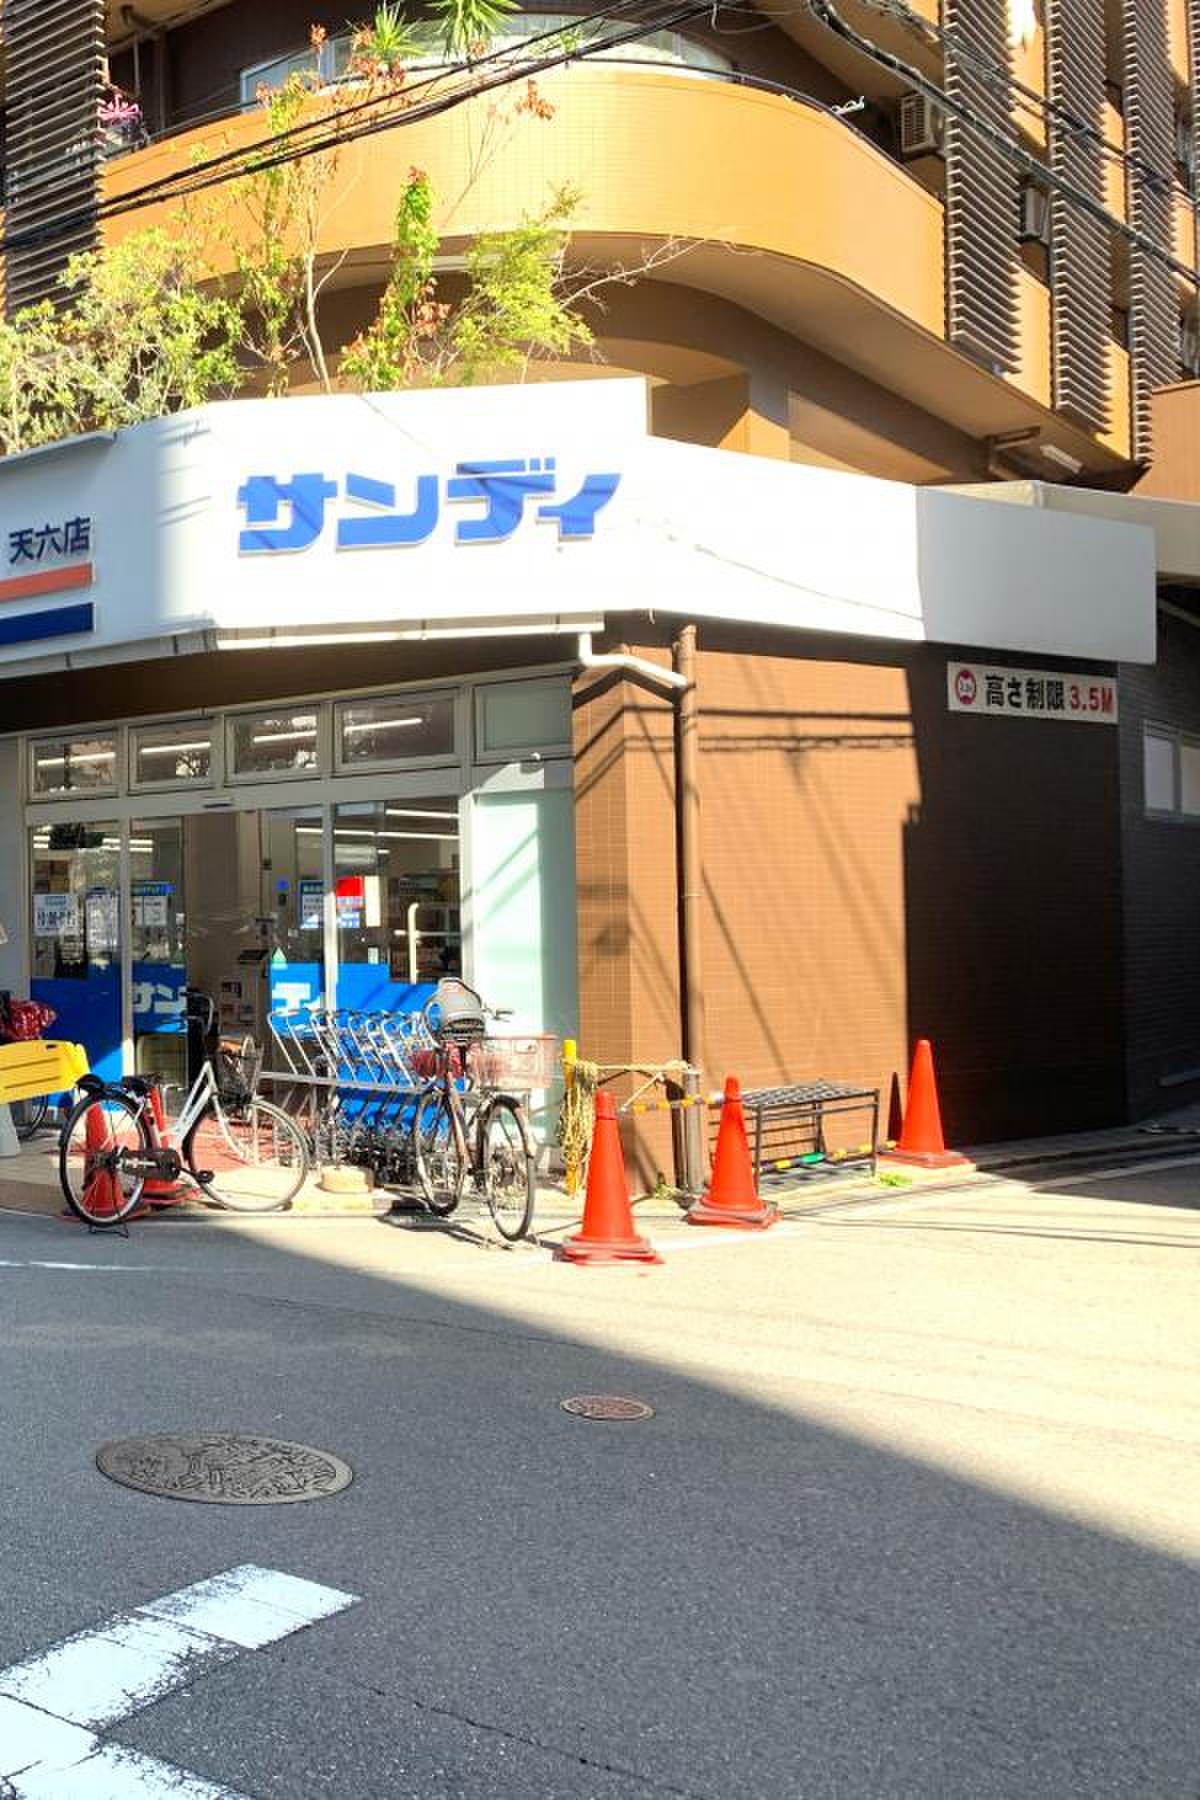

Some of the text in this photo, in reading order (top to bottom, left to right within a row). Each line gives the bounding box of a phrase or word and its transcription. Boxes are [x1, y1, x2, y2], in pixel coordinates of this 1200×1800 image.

[8, 516, 91, 564] 天六店
[238, 457, 622, 552] サンディ
